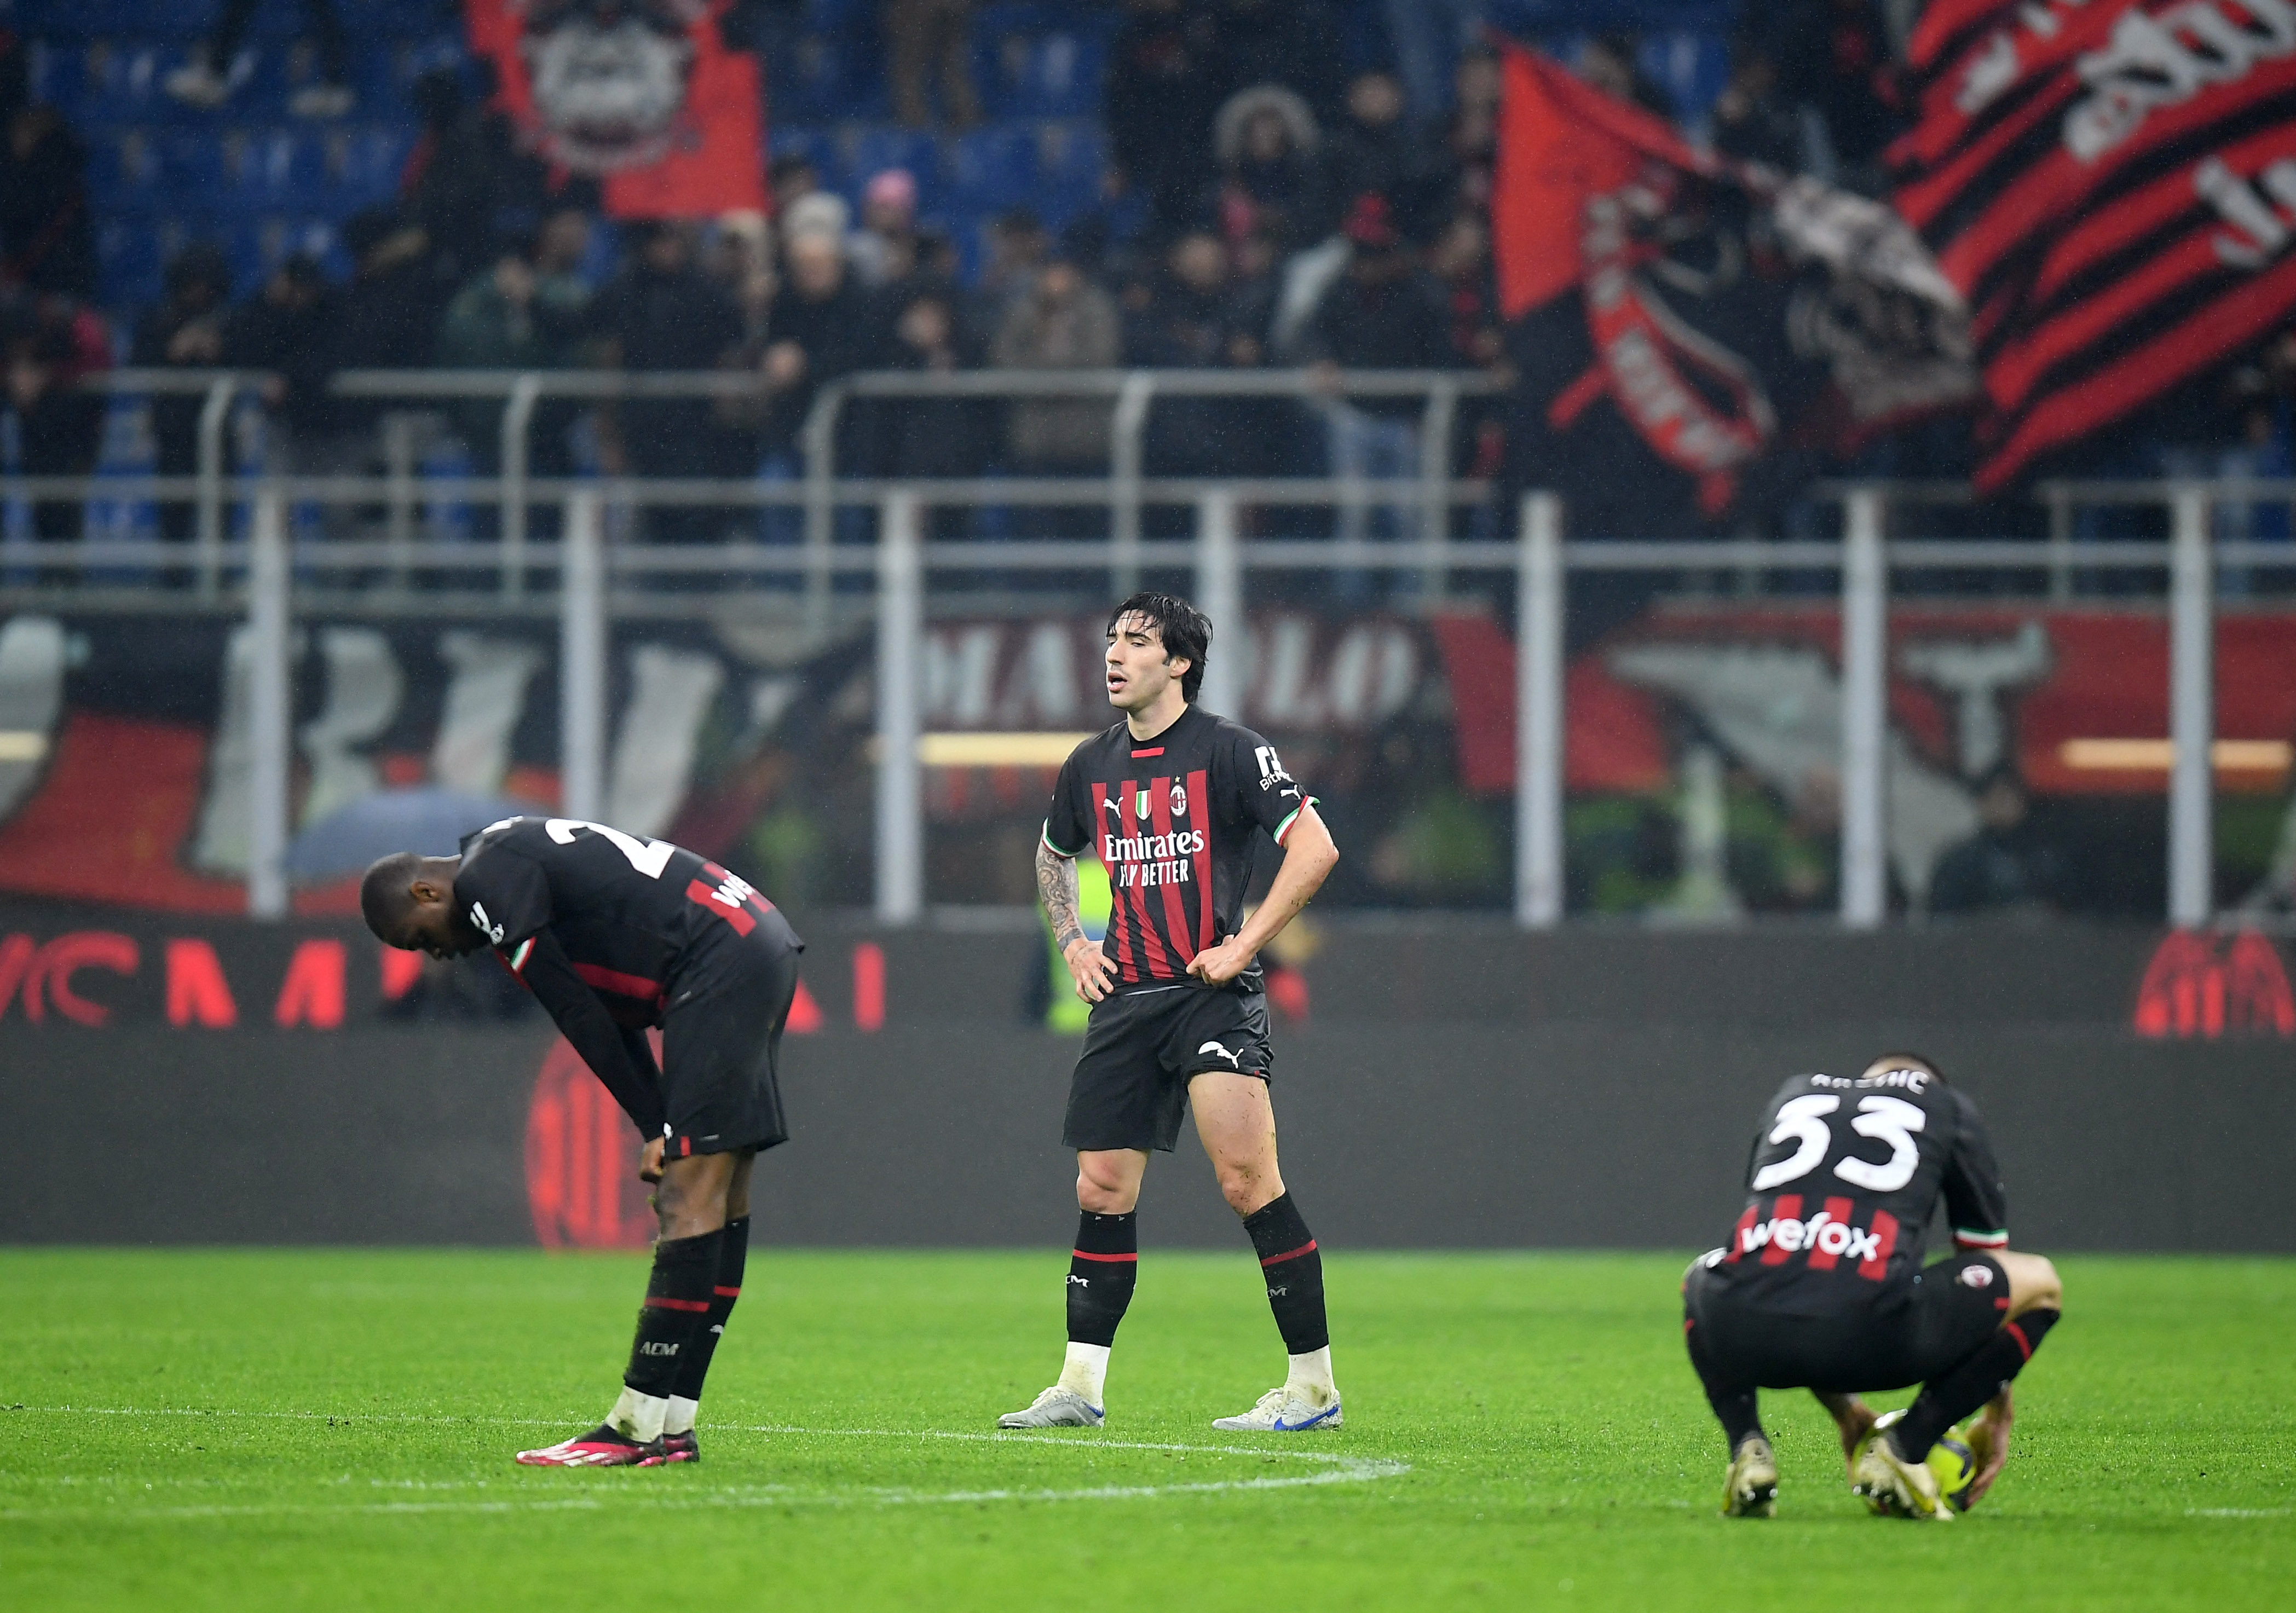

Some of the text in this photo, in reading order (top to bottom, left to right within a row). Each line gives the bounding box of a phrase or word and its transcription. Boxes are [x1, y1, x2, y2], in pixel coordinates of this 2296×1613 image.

[545, 818, 676, 879] 2
[1104, 829, 1205, 862] Emirates
[1141, 859, 1189, 887] BETTER
[1741, 1211, 1882, 1262] wefox
[1065, 1275, 1089, 1288] CM
[639, 1340, 680, 1356] ACM
